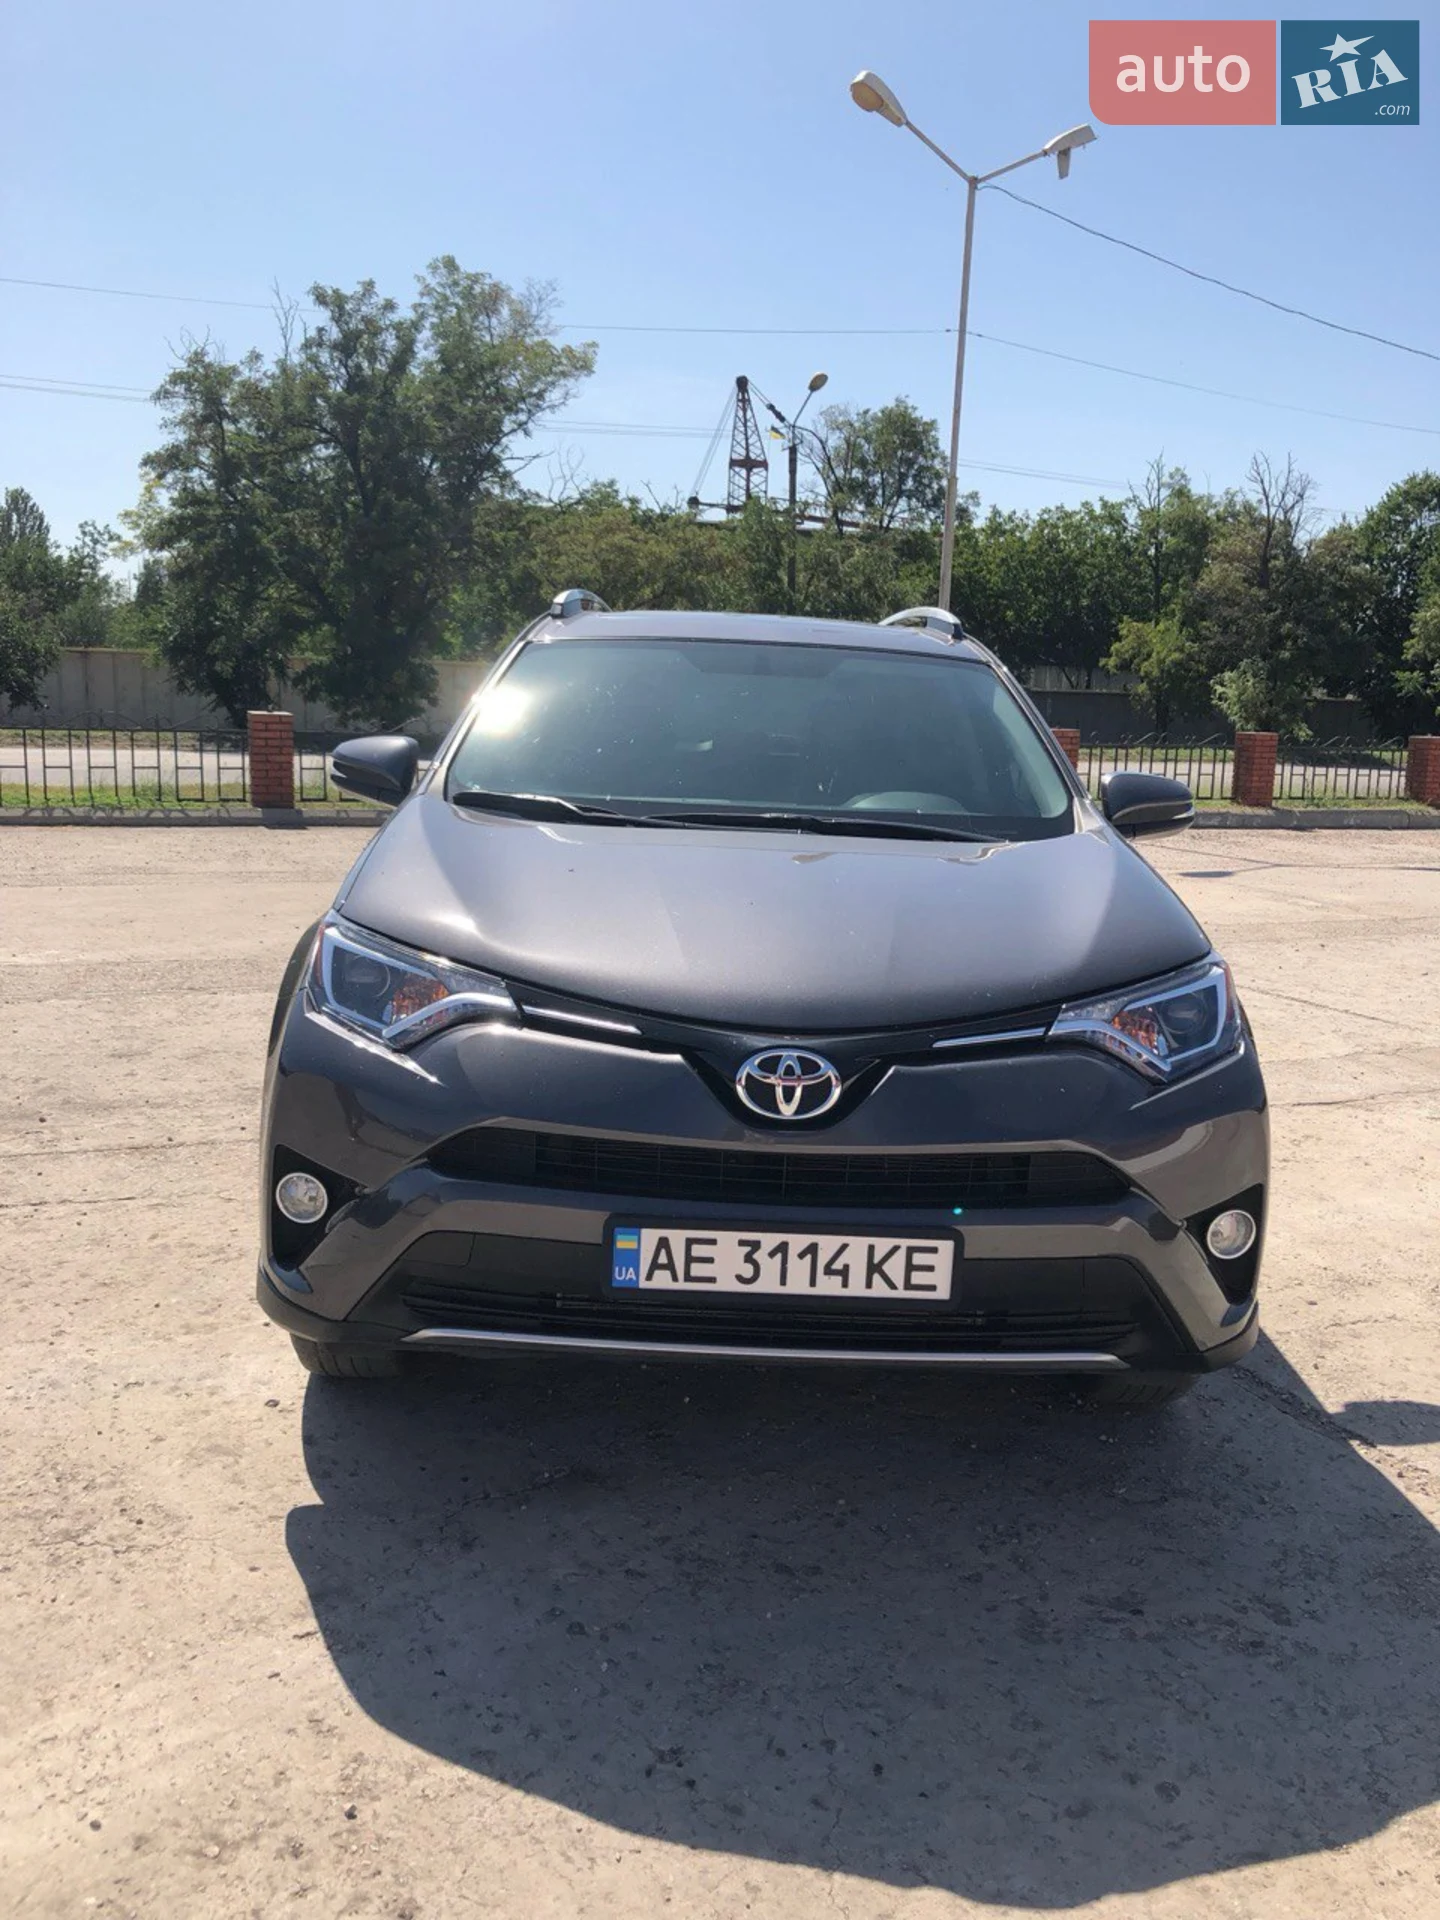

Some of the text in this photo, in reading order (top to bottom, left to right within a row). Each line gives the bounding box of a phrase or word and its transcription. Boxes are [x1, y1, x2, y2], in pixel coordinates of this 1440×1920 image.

[614, 1266, 636, 1281] UA
[645, 1236, 938, 1292] AE 3114 KE
